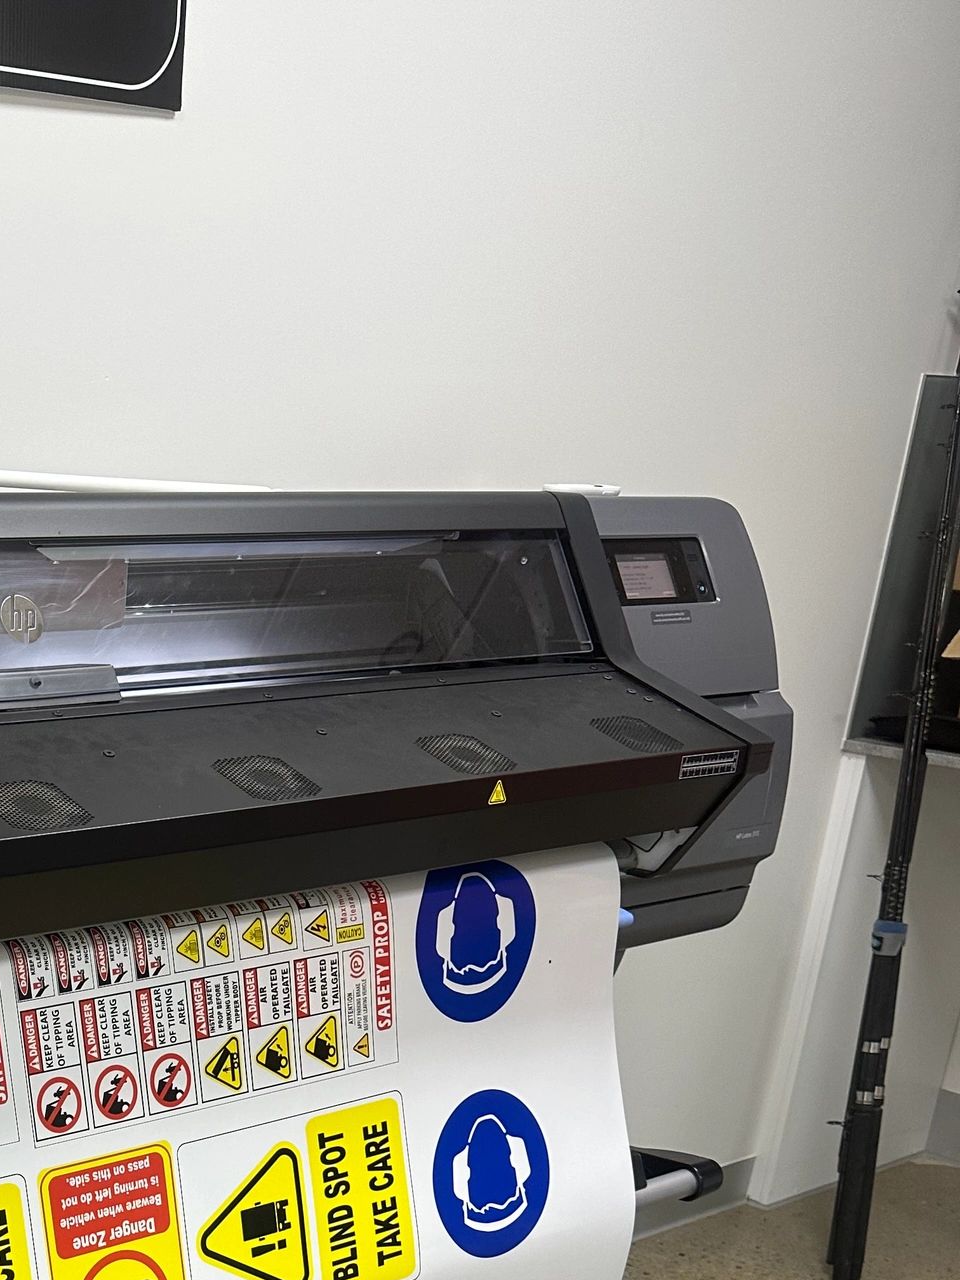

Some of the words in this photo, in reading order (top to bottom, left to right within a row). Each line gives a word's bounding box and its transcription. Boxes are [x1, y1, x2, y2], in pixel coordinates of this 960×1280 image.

[8, 594, 38, 644] hp
[373, 911, 389, 961] PROP
[247, 971, 259, 1013] DANGER
[270, 969, 280, 1019] OPERATED
[282, 968, 291, 1016] TAILGATE
[296, 961, 308, 1002] DANGER
[309, 976, 317, 993] AIR
[320, 959, 328, 1009] OPERATED
[331, 959, 340, 1006] TAILGATE
[154, 989, 163, 1020] CLEAR
[194, 980, 207, 1021] DANGER
[260, 986, 268, 1003] AIR
[376, 965, 391, 1028] SAFETY
[98, 999, 107, 1032] CLEAR
[109, 999, 120, 1039] TIPPING
[140, 993, 153, 1034] DANGER
[165, 988, 175, 1029] TIPPING
[177, 1000, 186, 1025] AREA
[25, 1014, 38, 1056] DANGER
[40, 1010, 49, 1043] CLEAR
[52, 1010, 64, 1050] TIPPING
[66, 1021, 75, 1047] AREA
[84, 1004, 96, 1046] DANGER
[122, 1010, 132, 1035] AREA
[158, 1023, 166, 1044] KEEP
[102, 1034, 110, 1056] KEEP
[115, 1043, 122, 1054] OF
[169, 1032, 177, 1043] OF
[45, 1045, 53, 1068] KEEP
[57, 1054, 65, 1066] OF
[128, 1156, 150, 1171] pass
[318, 1133, 350, 1198] SPOT
[363, 1121, 394, 1191] CARE
[66, 1174, 90, 1188] side.
[93, 1168, 111, 1180] this
[114, 1165, 125, 1175] on
[151, 1176, 159, 1186] is
[80, 1193, 92, 1204] do
[95, 1188, 111, 1201] left
[114, 1178, 148, 1194] turning
[61, 1199, 78, 1210] not
[97, 1204, 123, 1218] when
[126, 1194, 162, 1210] Beware
[60, 1212, 95, 1229] vehicle
[110, 1217, 155, 1240] Danger
[372, 1196, 402, 1266] TAKE
[73, 1230, 106, 1249] Zone
